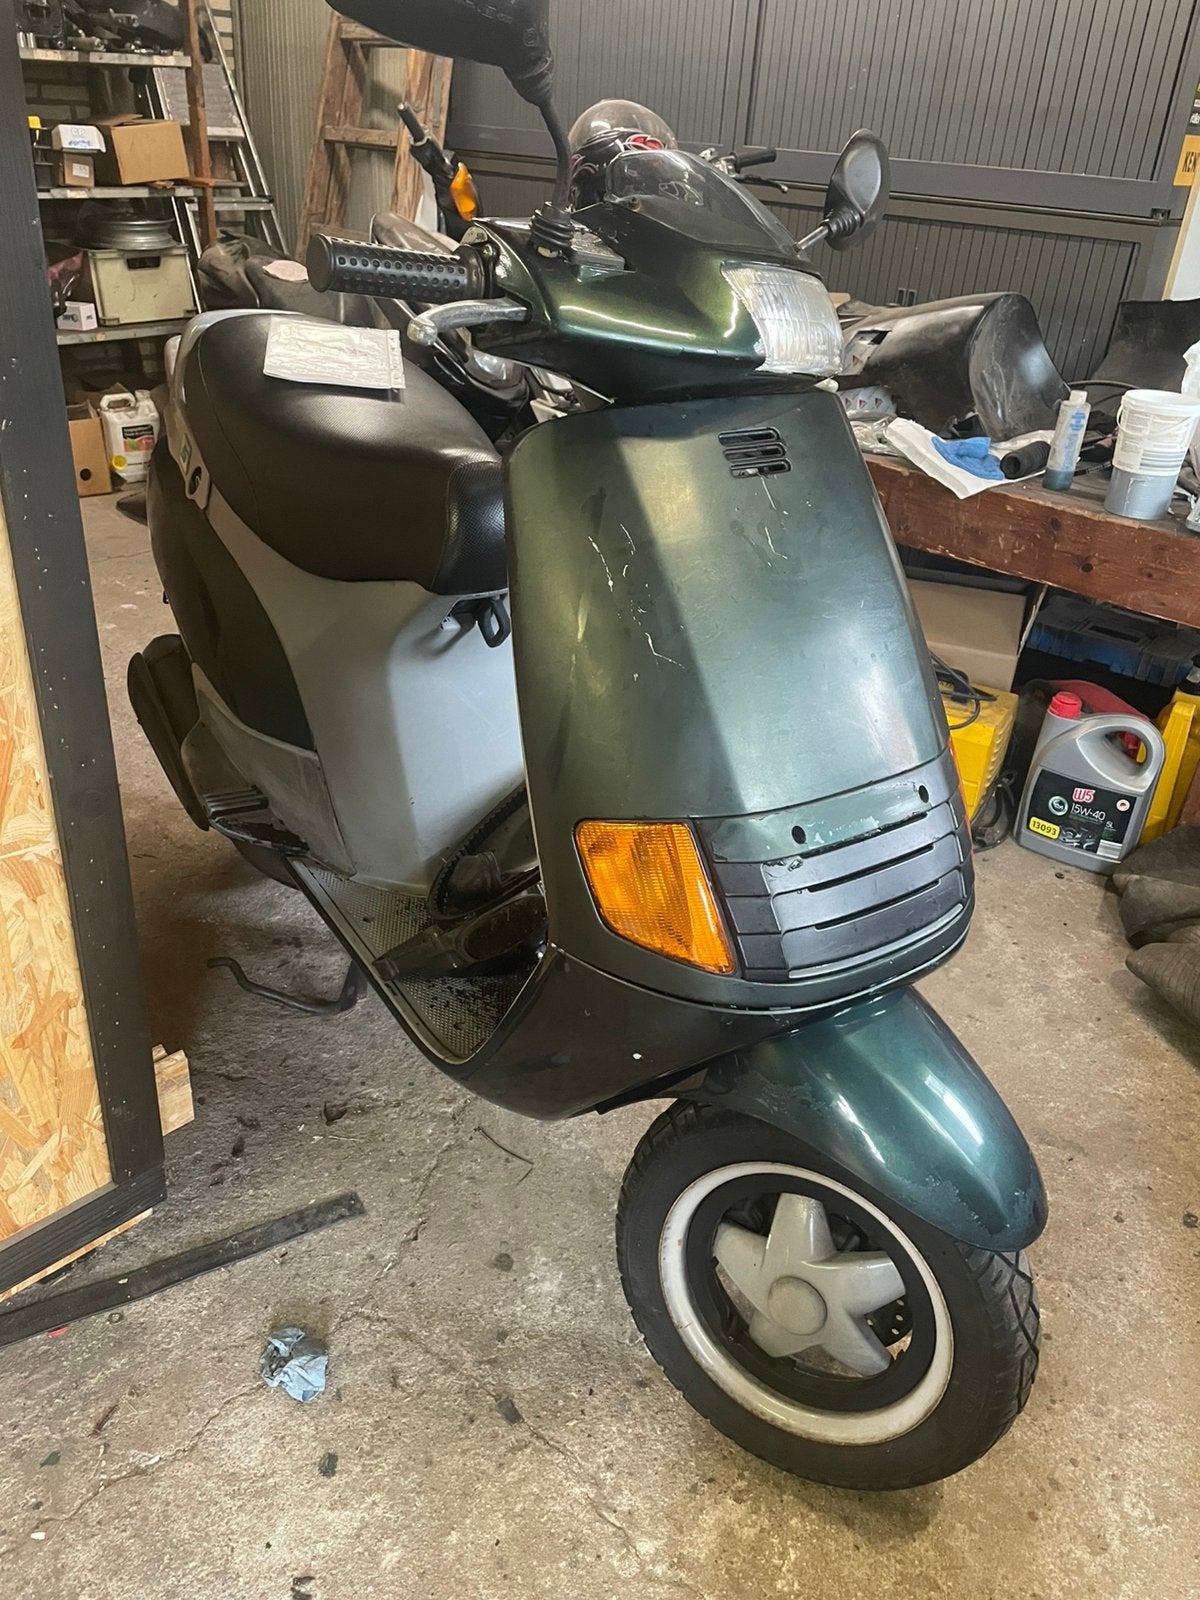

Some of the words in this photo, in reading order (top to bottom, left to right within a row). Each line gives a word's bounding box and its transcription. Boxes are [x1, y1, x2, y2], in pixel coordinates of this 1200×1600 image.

[1072, 788, 1095, 803] W5
[1071, 803, 1105, 820] 15W-40
[1032, 820, 1057, 836] 13093
